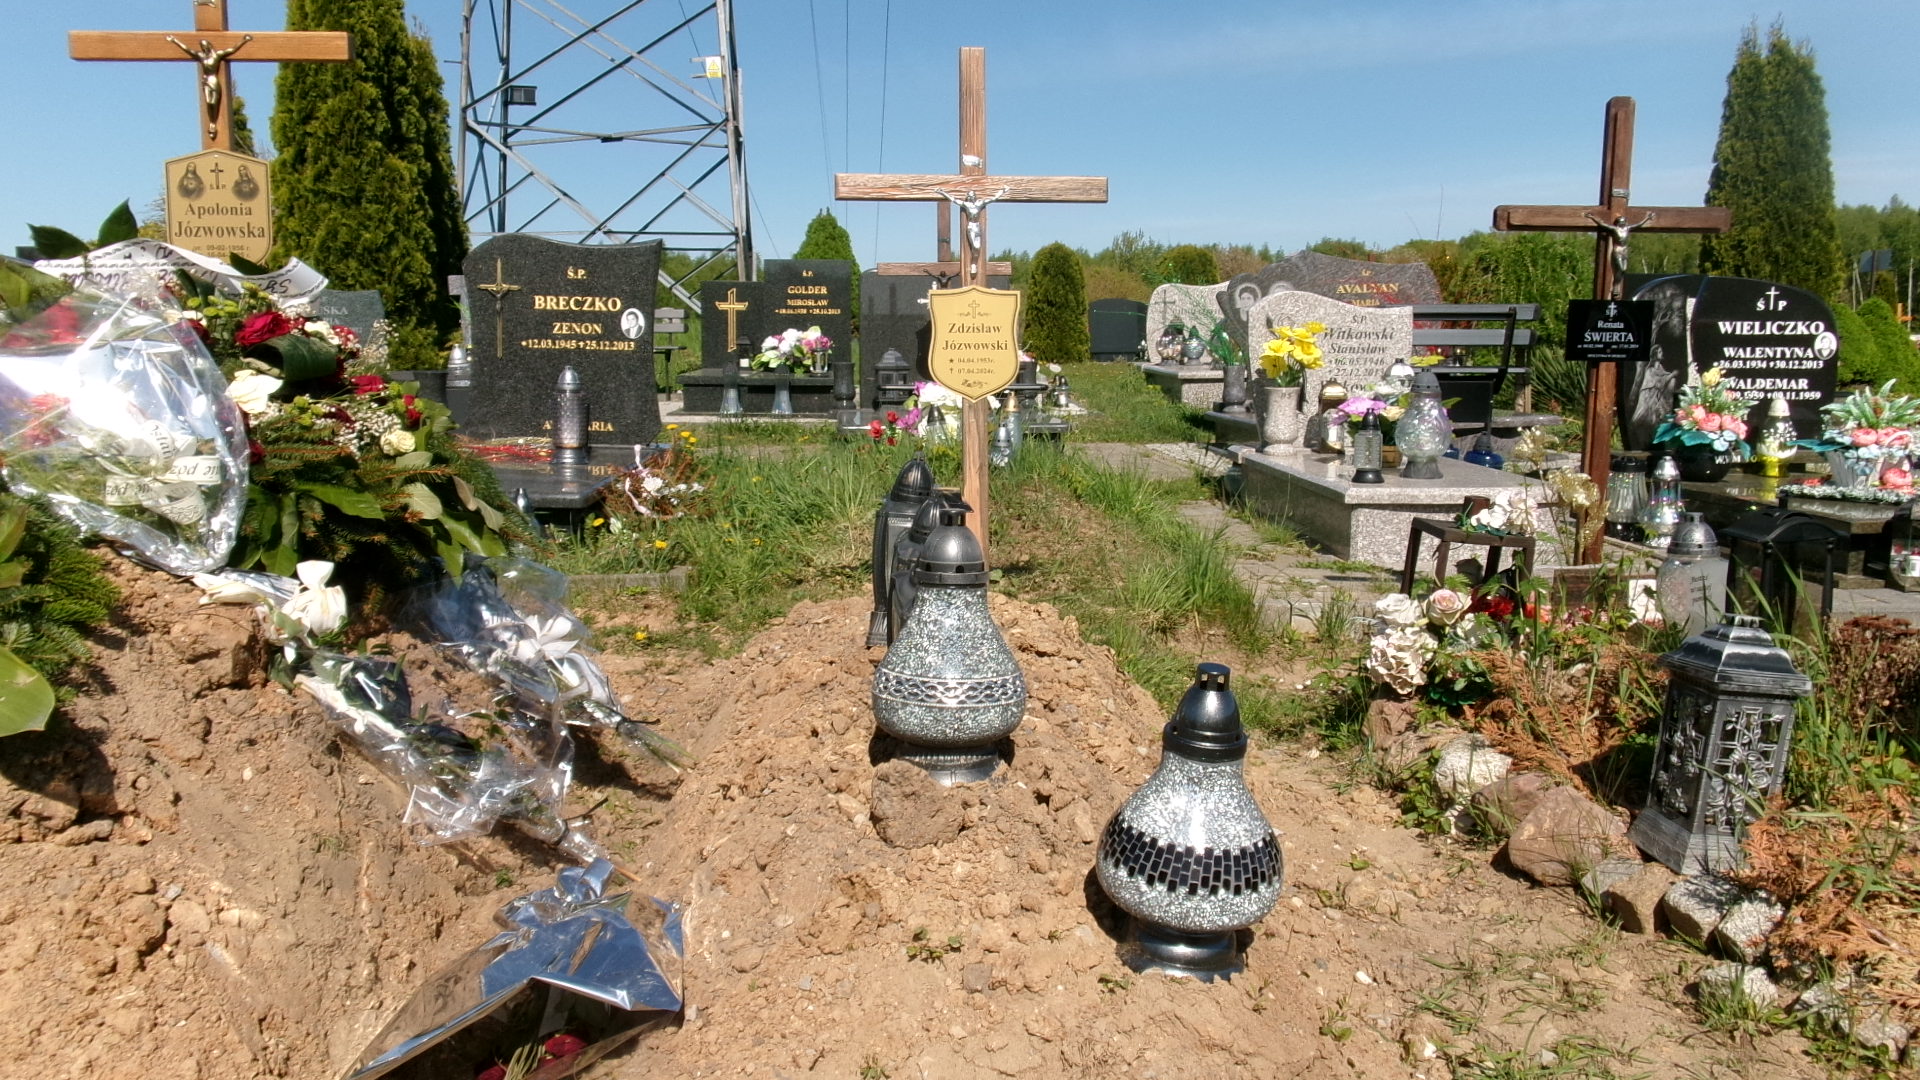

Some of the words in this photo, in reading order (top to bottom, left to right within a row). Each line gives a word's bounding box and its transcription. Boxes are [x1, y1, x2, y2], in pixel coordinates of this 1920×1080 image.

[185, 203, 252, 219] Apolonia
[174, 221, 265, 238] Józwowska
[567, 266, 587, 279] Ś.P.
[787, 285, 828, 294] GOLDER
[533, 295, 622, 312] BRECZKO
[1778, 300, 1787, 311] P
[552, 322, 602, 335] ZENON
[1323, 327, 1395, 341] Witkowski
[1718, 320, 1825, 336] WIELICZKO
[1584, 329, 1634, 342] ŚWIERTA
[527, 339, 576, 349] 12.03.1945
[584, 340, 635, 350] 25.12.2013
[942, 340, 1008, 351] Józwowski
[1723, 347, 1814, 359] WALENTYNA
[1727, 378, 1809, 390] WALDEMAR
[588, 421, 614, 431] RIA
